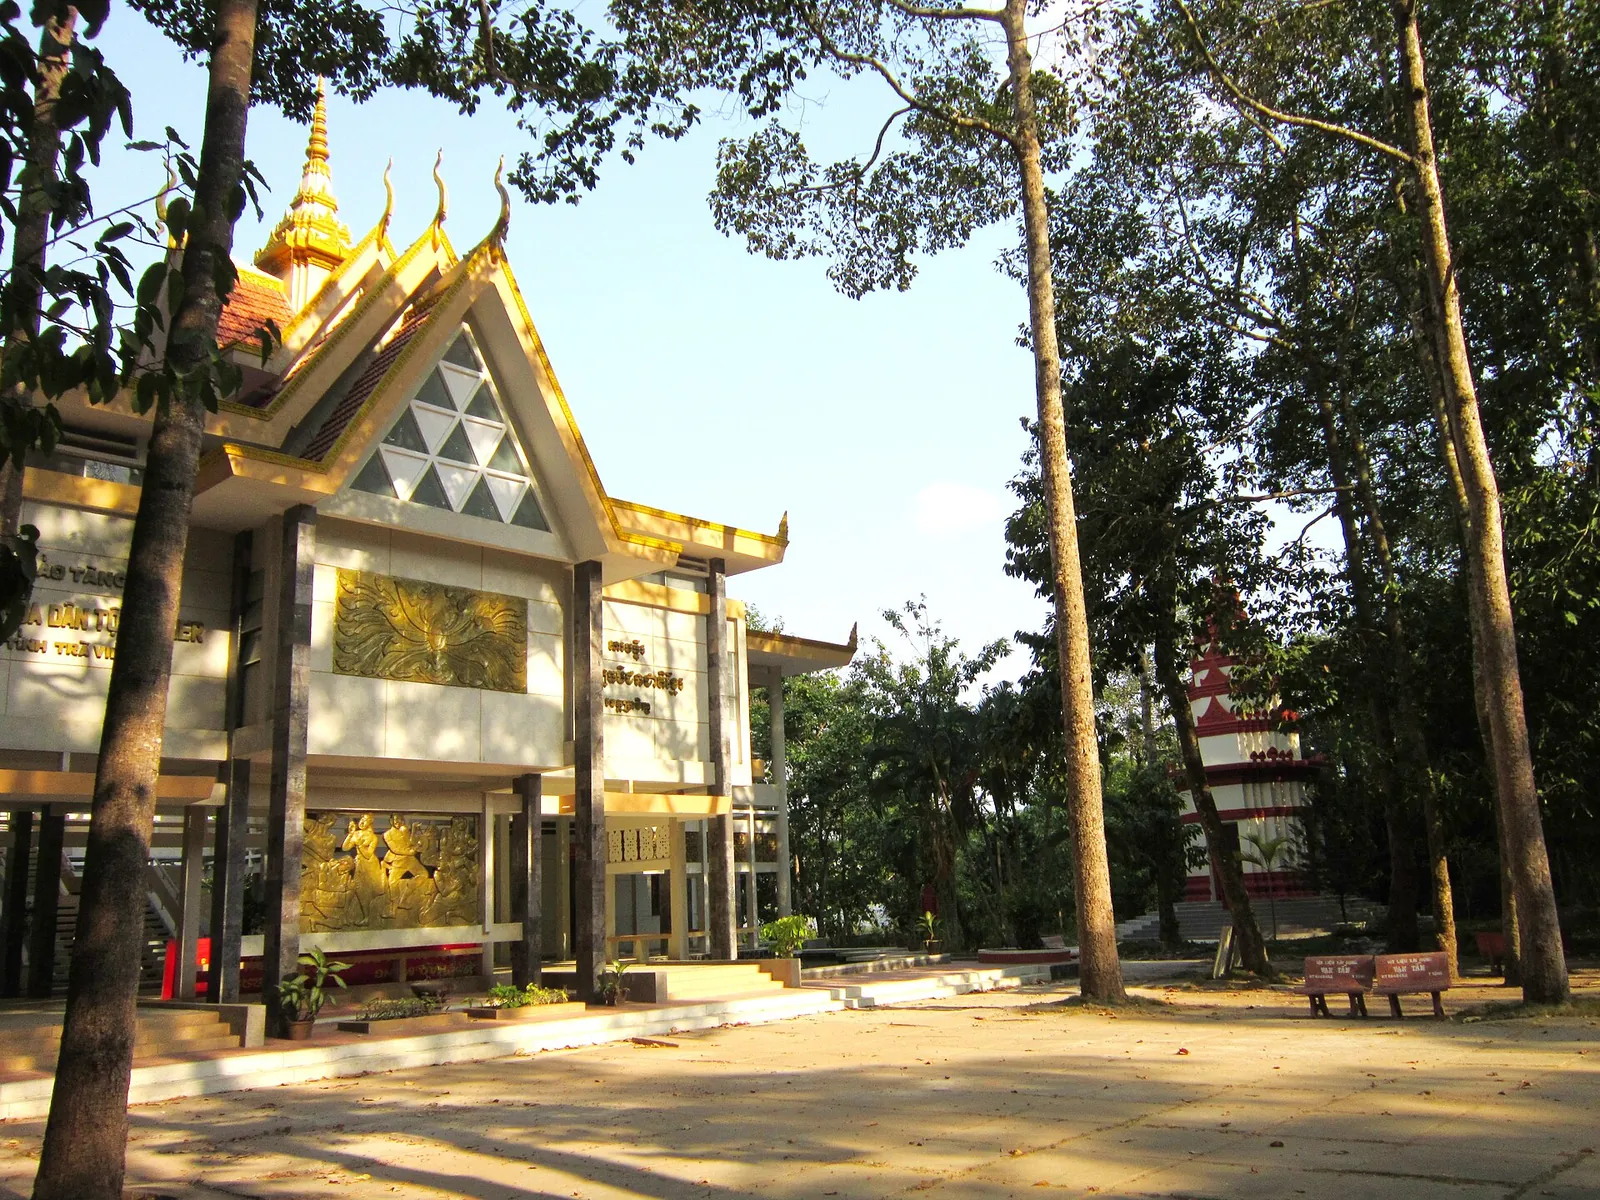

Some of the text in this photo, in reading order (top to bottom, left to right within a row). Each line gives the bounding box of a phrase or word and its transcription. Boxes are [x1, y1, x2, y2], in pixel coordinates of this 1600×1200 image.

[36, 553, 66, 581] ẢO
[48, 601, 90, 632] DÂN
[94, 607, 120, 637] TỘ
